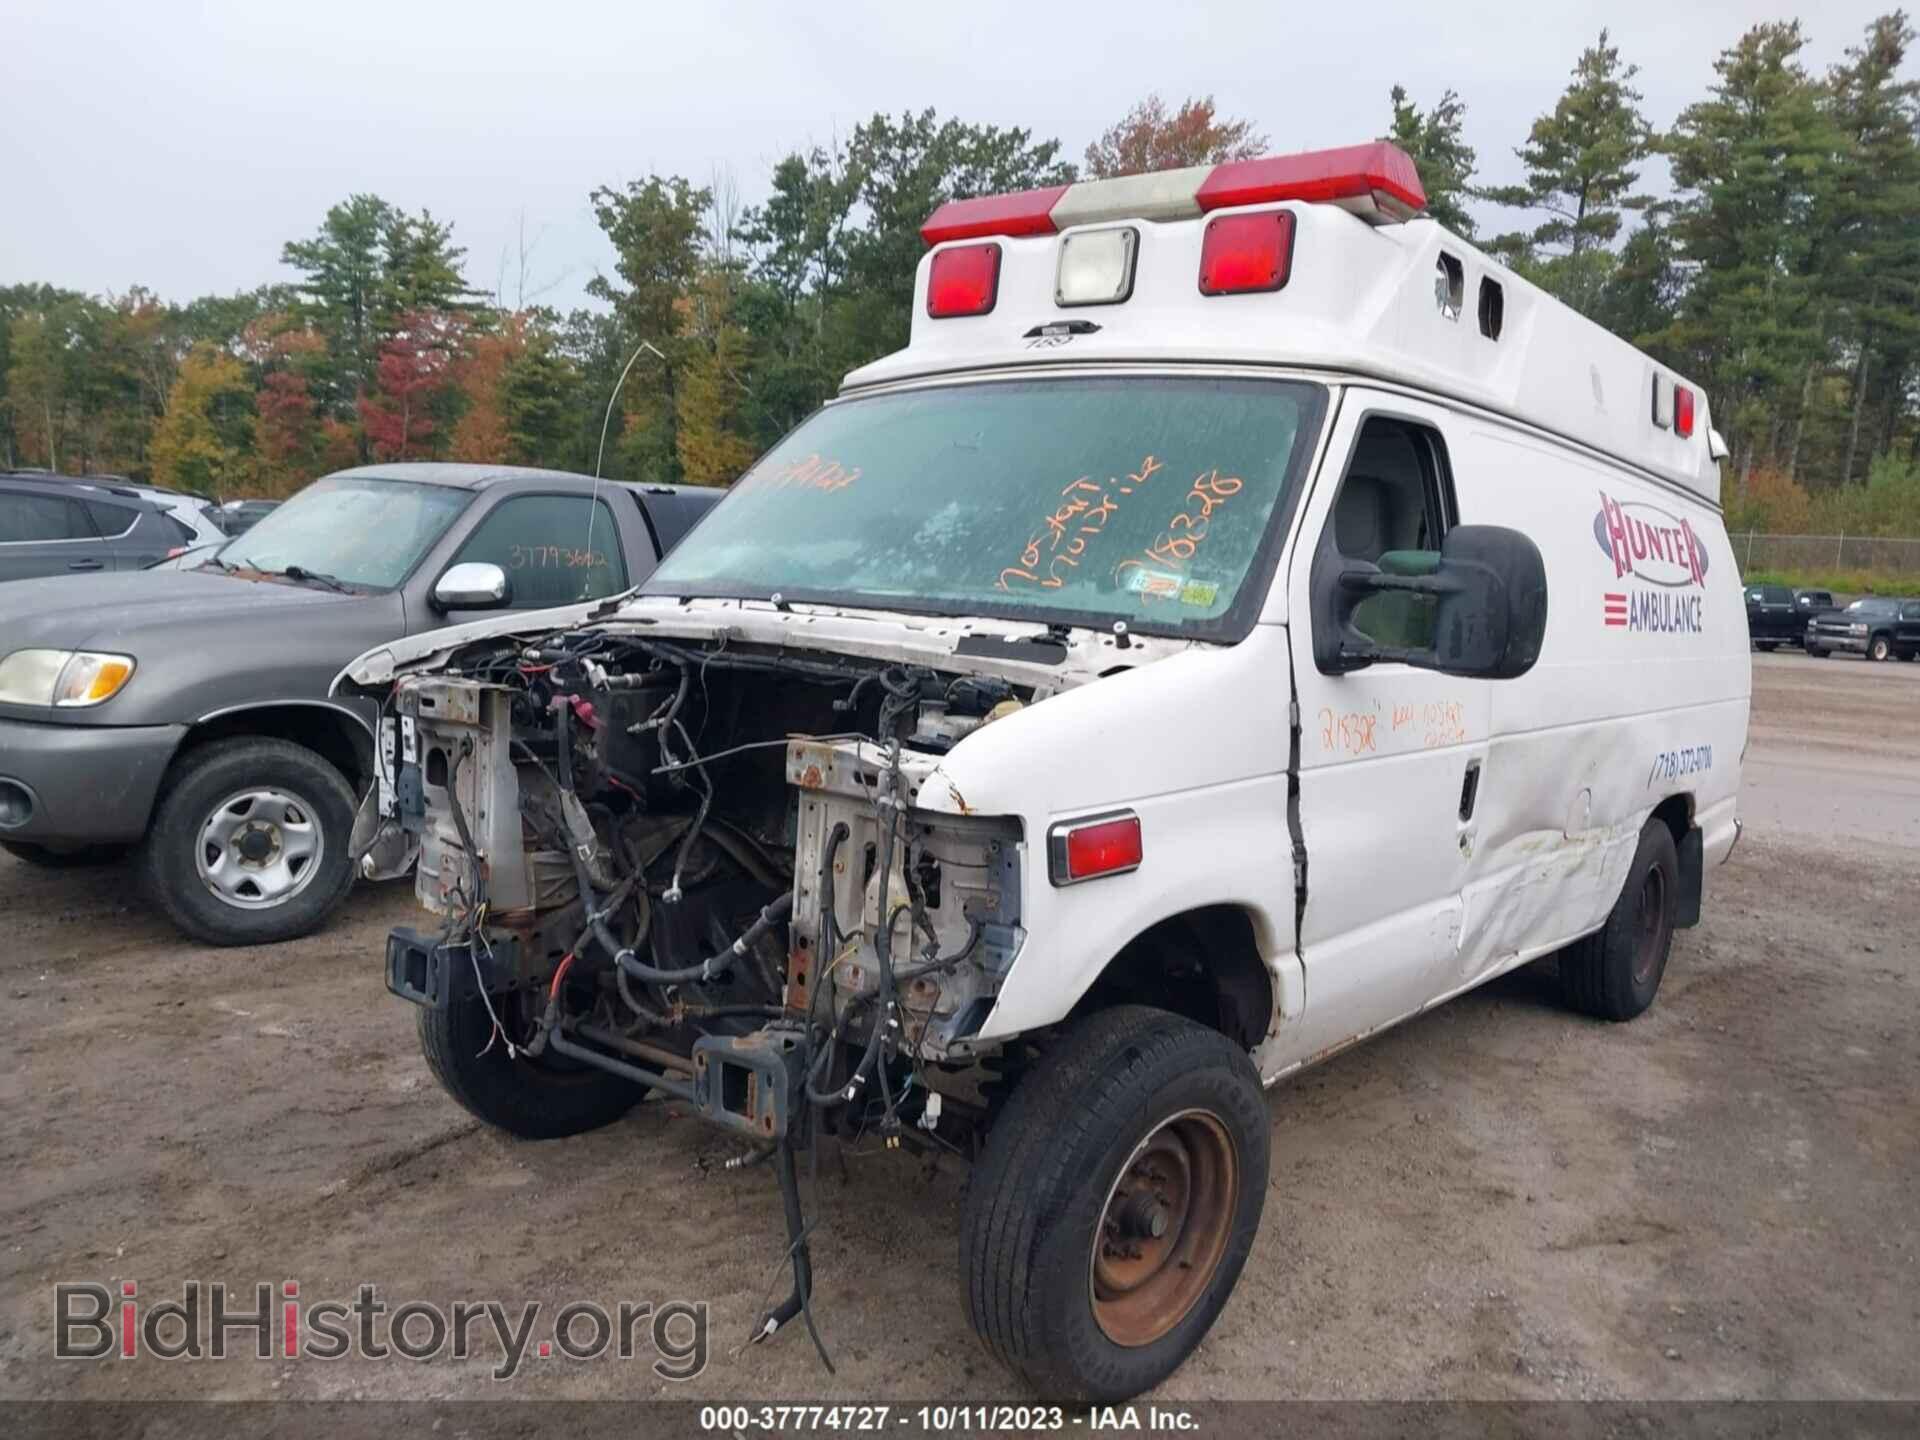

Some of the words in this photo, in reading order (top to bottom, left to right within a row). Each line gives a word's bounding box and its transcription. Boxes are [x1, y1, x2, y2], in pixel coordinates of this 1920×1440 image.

[1599, 490, 1705, 589] HUNTER
[1629, 590, 1703, 633] AMBULANCE
[1646, 751, 1679, 791] (718)
